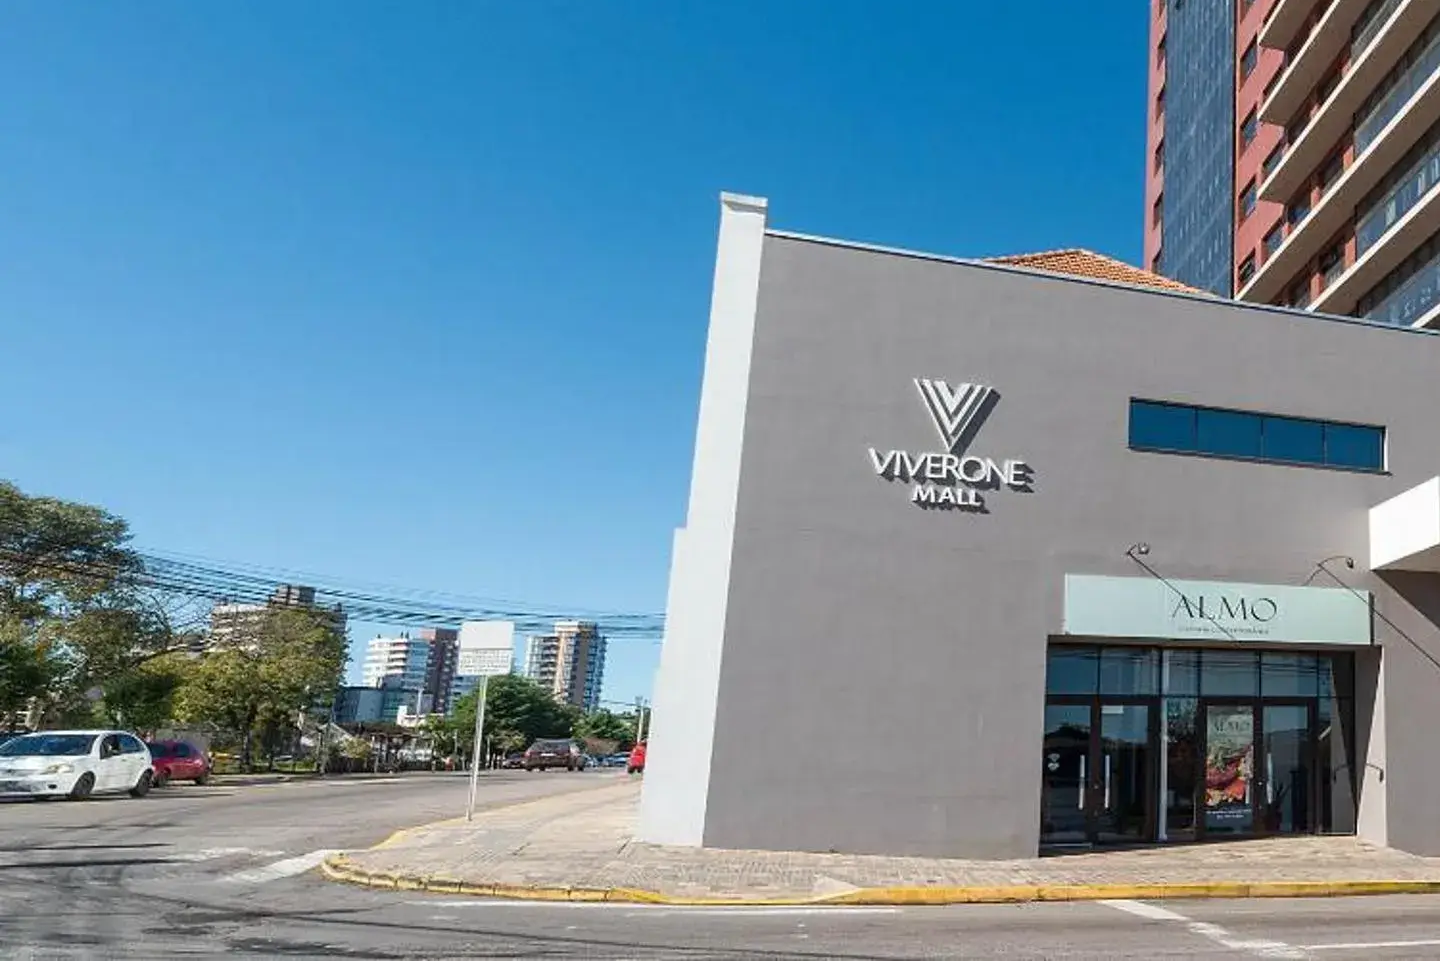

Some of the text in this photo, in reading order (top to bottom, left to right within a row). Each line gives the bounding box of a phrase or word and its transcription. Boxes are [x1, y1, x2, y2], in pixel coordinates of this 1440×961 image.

[868, 447, 1027, 485] VIVERONE
[912, 485, 982, 506] MALL
[1172, 595, 1278, 622] ALMO
